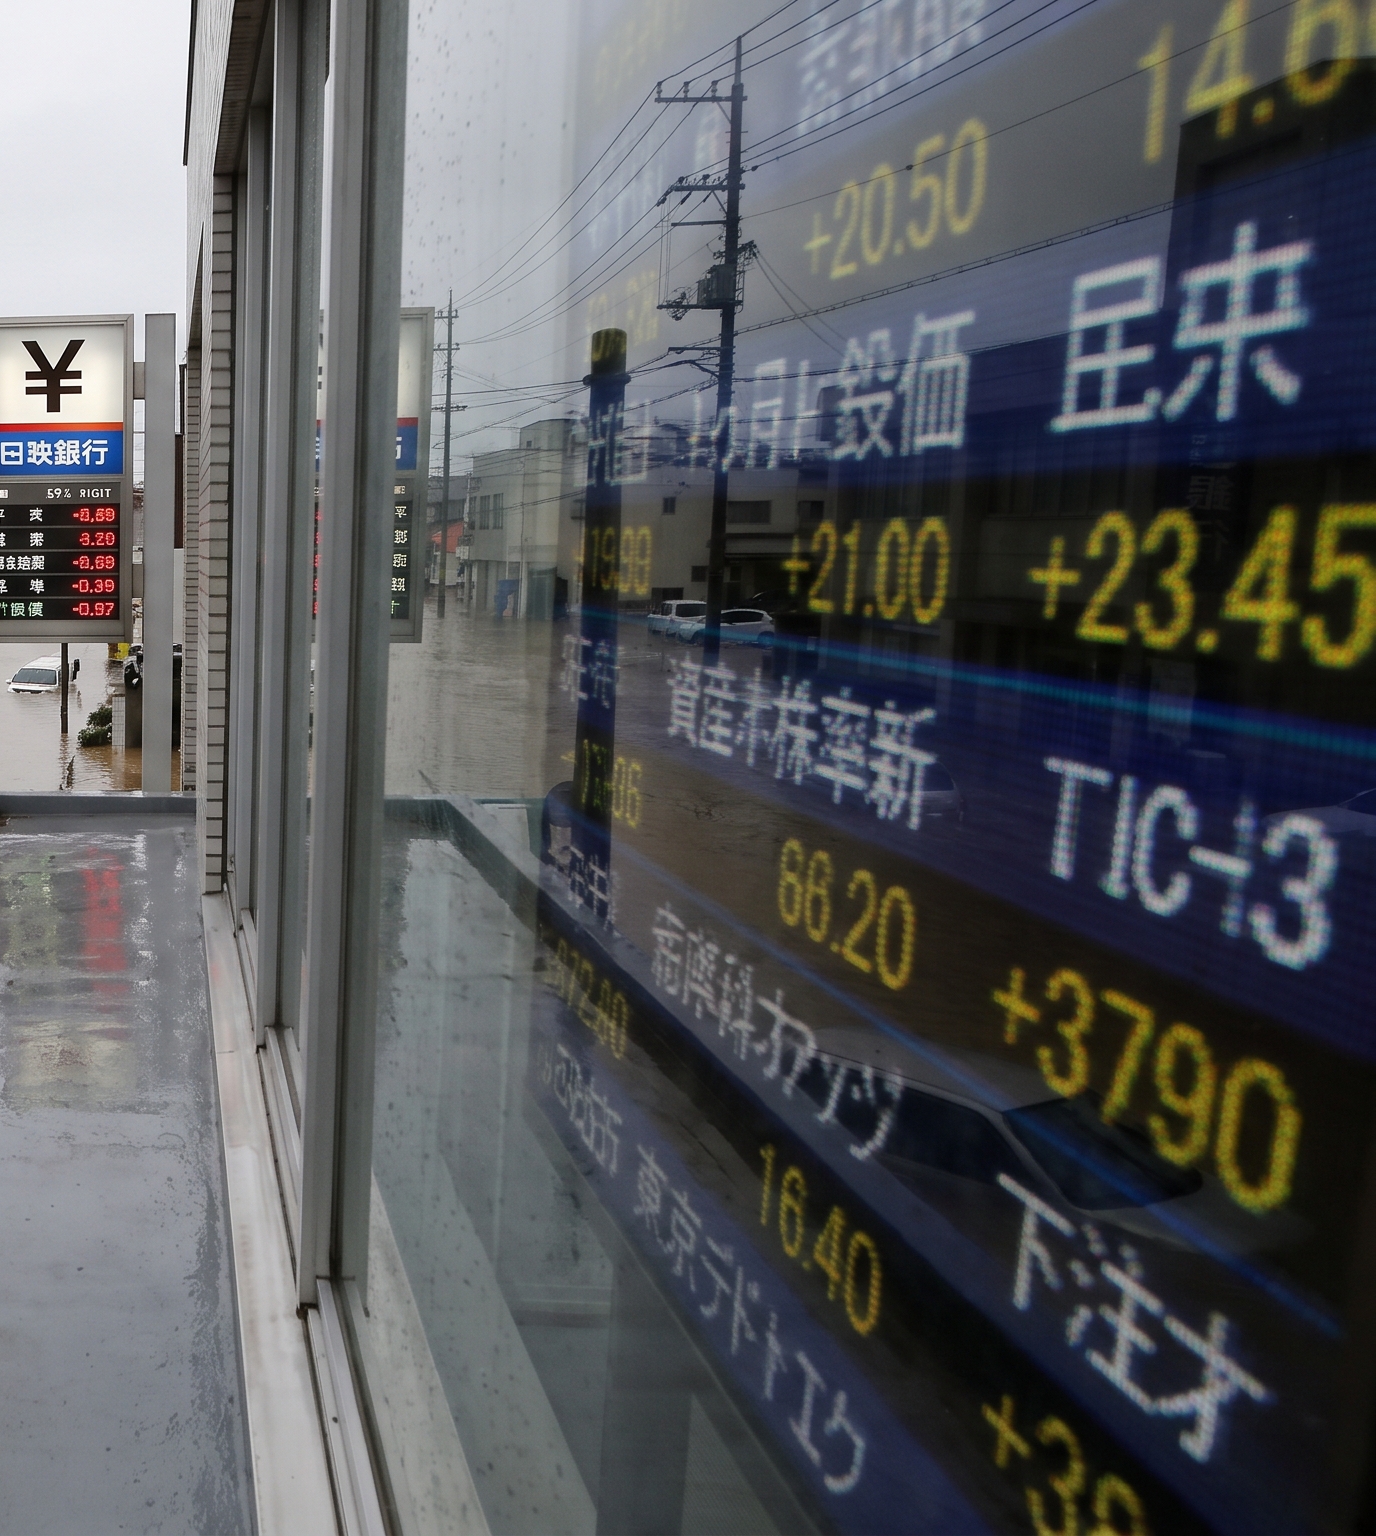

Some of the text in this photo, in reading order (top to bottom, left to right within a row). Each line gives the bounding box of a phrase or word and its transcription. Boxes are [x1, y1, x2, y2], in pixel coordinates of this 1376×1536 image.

[803, 117, 989, 280] +20.50
[781, 516, 950, 625] +21.00
[993, 966, 1302, 1214] +3790
[760, 1143, 882, 1336] 16.40
